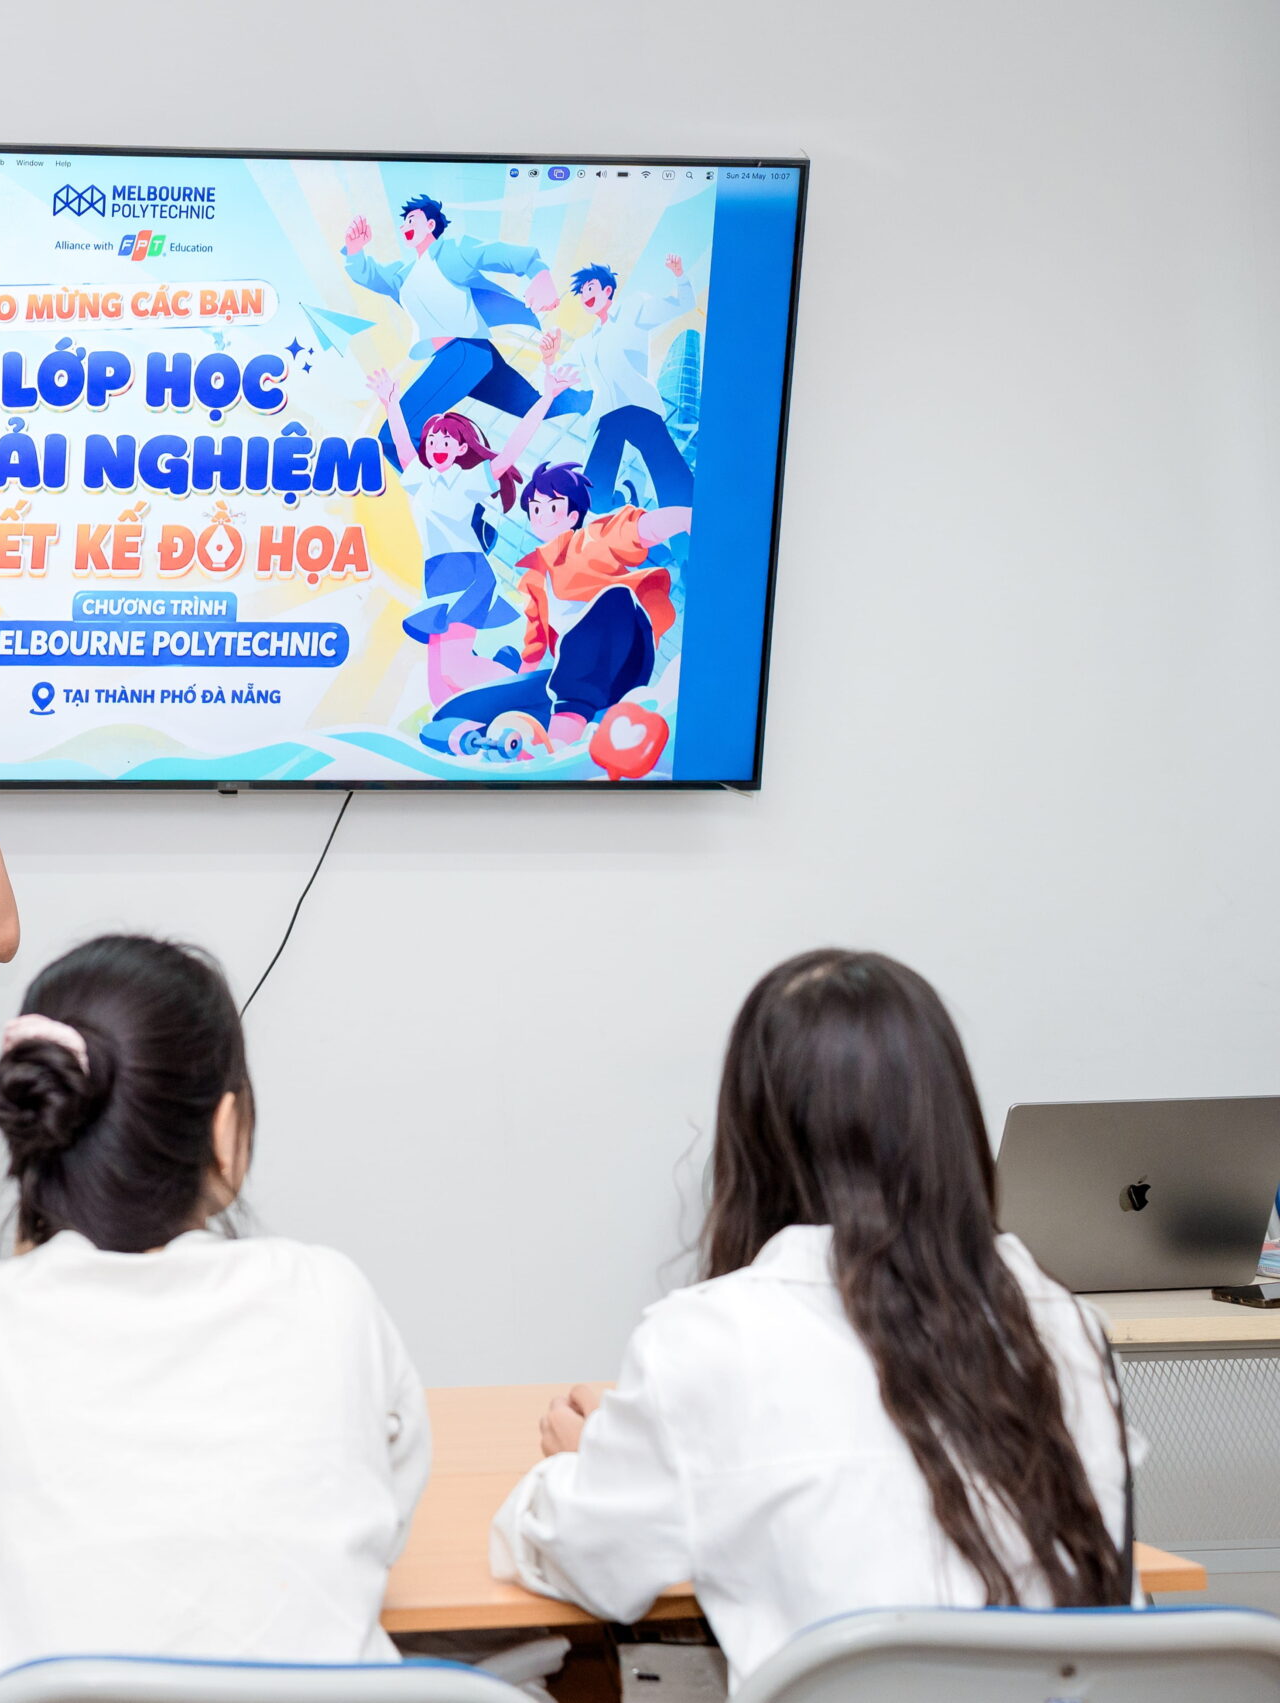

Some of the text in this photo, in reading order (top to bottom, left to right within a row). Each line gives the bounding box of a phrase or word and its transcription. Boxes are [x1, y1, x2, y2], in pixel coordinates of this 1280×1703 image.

[16, 159, 44, 167] Window
[752, 173, 766, 181] May
[112, 184, 216, 202] MELBOURNE
[111, 203, 215, 220] POLYTECHNIC
[55, 230, 213, 262] Alliance with FPT Education
[25, 286, 121, 320] MỪNG
[130, 284, 190, 317] CÁC
[200, 287, 263, 321] BẠN
[1, 336, 285, 422] LỚP HỌC
[83, 420, 382, 505] NGHIỆM
[74, 500, 148, 570] KẾ
[257, 525, 369, 585] HỌA
[82, 595, 227, 616] CHƯƠNG TRÌNH
[153, 632, 336, 657] POLYTECHNIC
[63, 683, 281, 706] TẠI THÀNH PHỐ ĐÀ NẴNG
